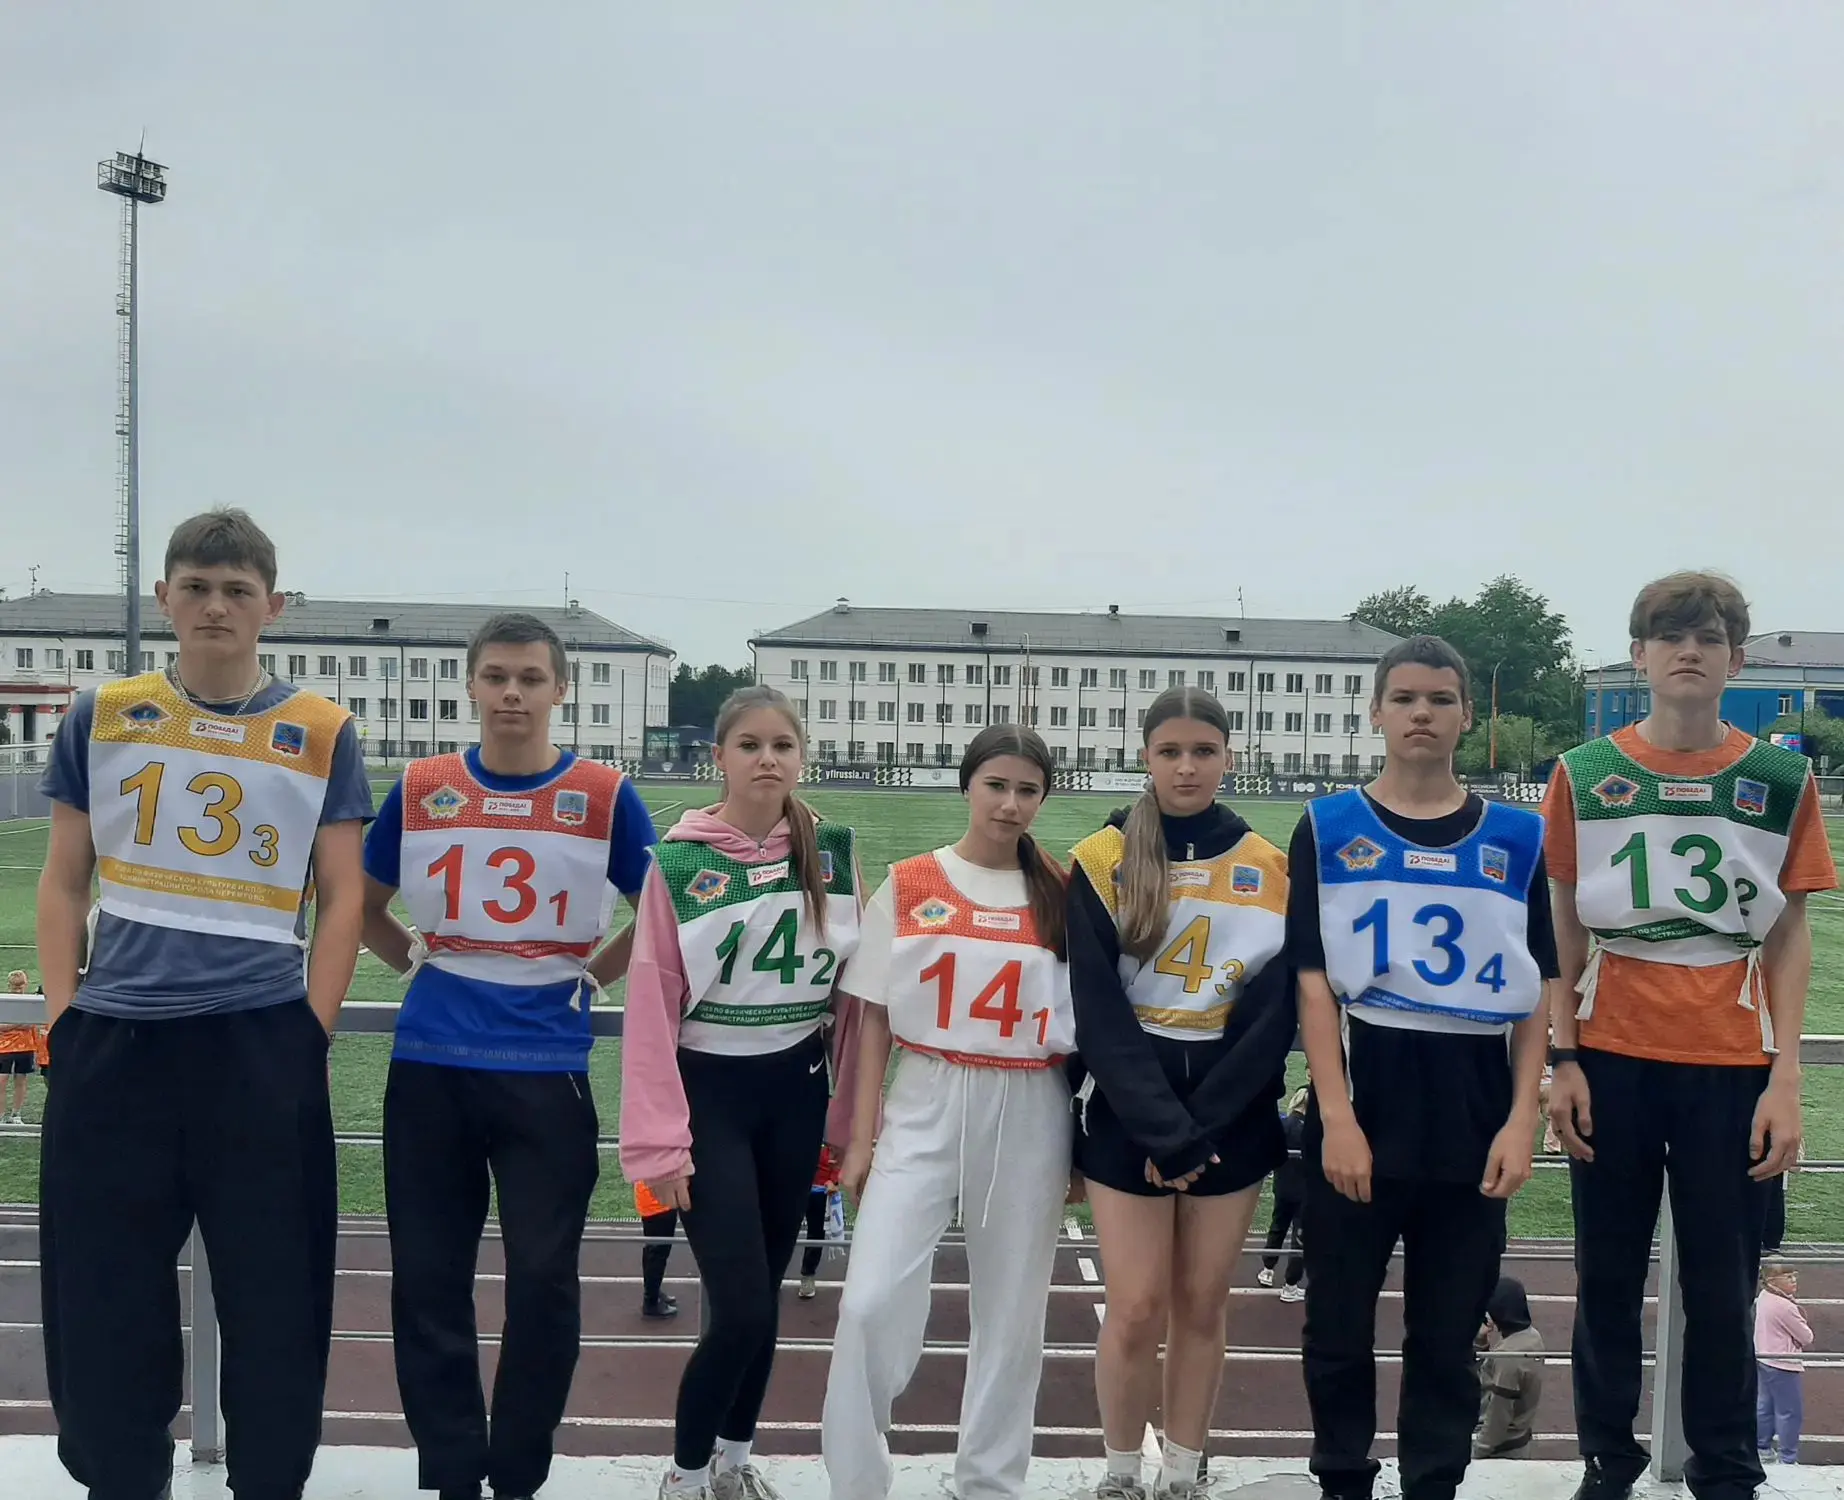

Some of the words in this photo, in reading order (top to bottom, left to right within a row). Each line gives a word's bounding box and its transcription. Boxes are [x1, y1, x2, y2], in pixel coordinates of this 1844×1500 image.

[119, 761, 243, 857] 13
[248, 824, 279, 867] 3
[426, 844, 537, 924] 13
[548, 889, 568, 927] 1
[1611, 832, 1729, 914] 13
[715, 908, 805, 985] 14
[810, 948, 836, 985] 2
[1214, 958, 1244, 996] 3
[1352, 898, 1469, 987] 13
[1475, 952, 1508, 994] 4
[918, 951, 1024, 1038] 14
[1031, 1007, 1050, 1046] 1
